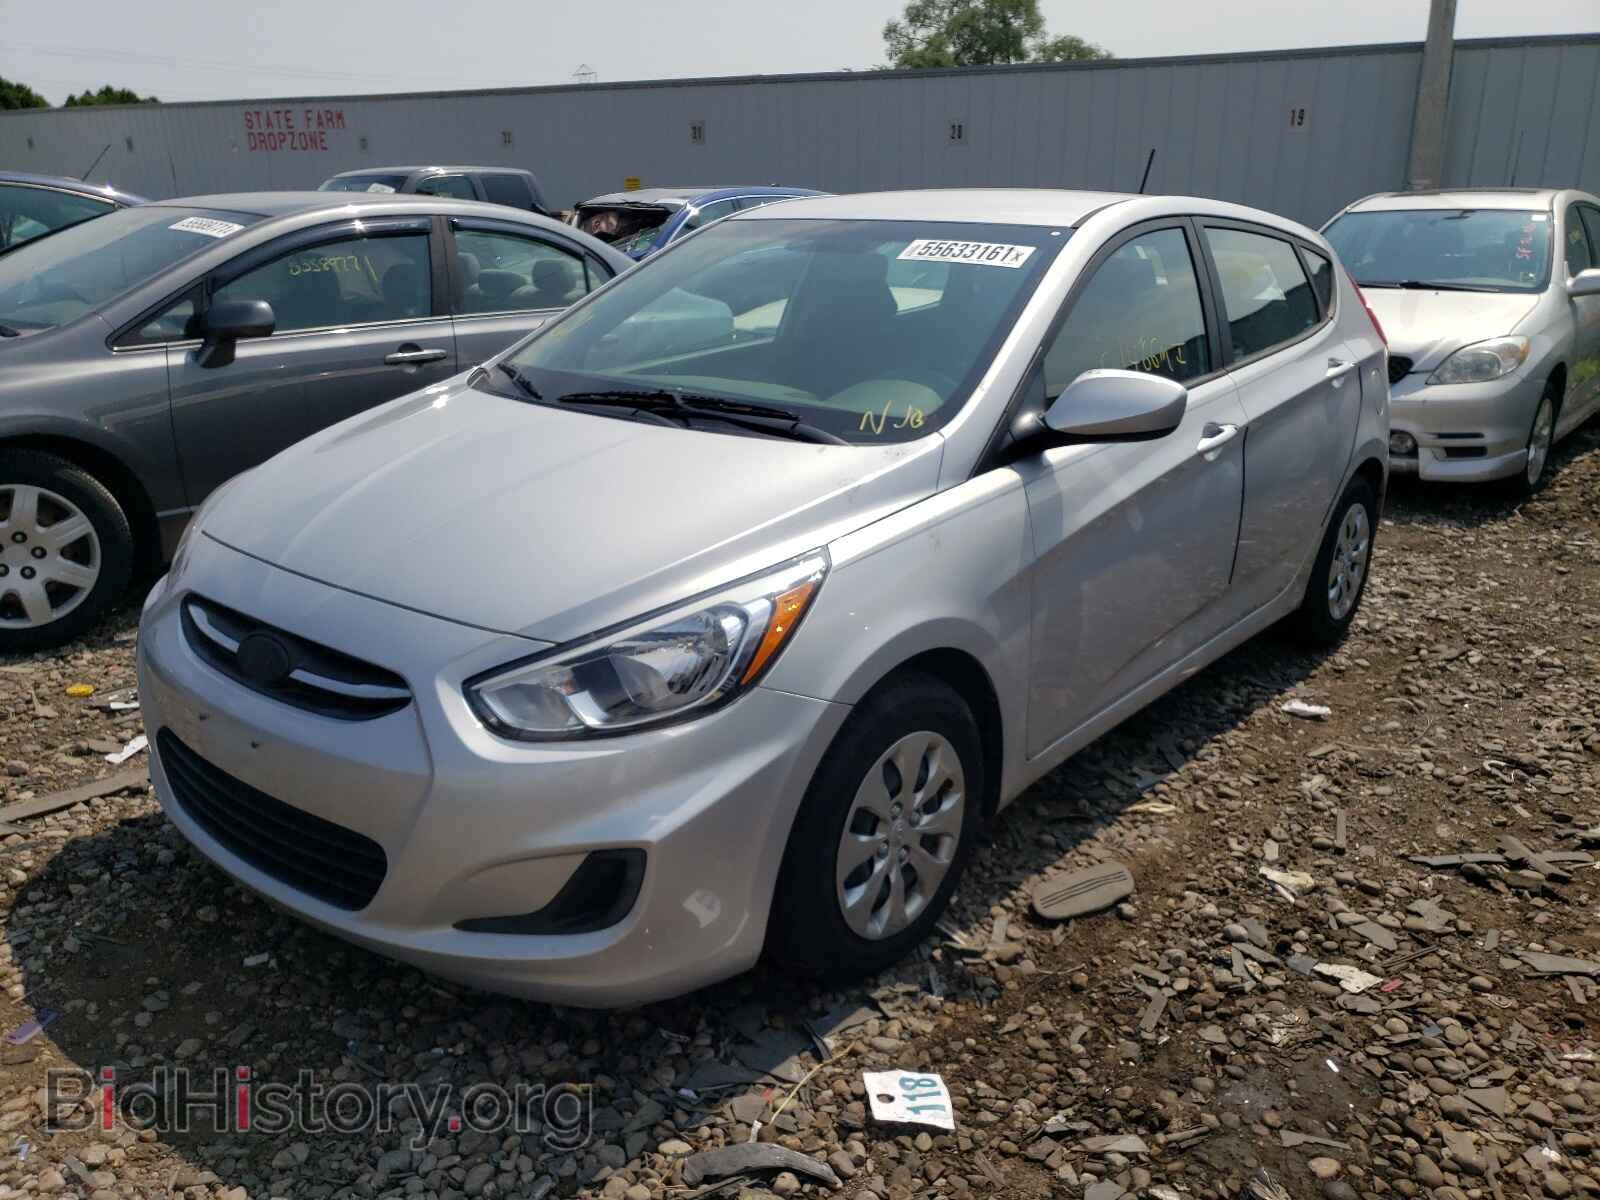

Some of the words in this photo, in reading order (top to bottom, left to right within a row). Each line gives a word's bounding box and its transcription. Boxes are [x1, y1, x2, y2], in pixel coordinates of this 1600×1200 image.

[244, 110, 294, 129] STATE
[304, 109, 346, 128] FARM
[248, 131, 328, 151] DROPZONE
[918, 241, 1015, 262] 55633161
[898, 1076, 946, 1115] 118
